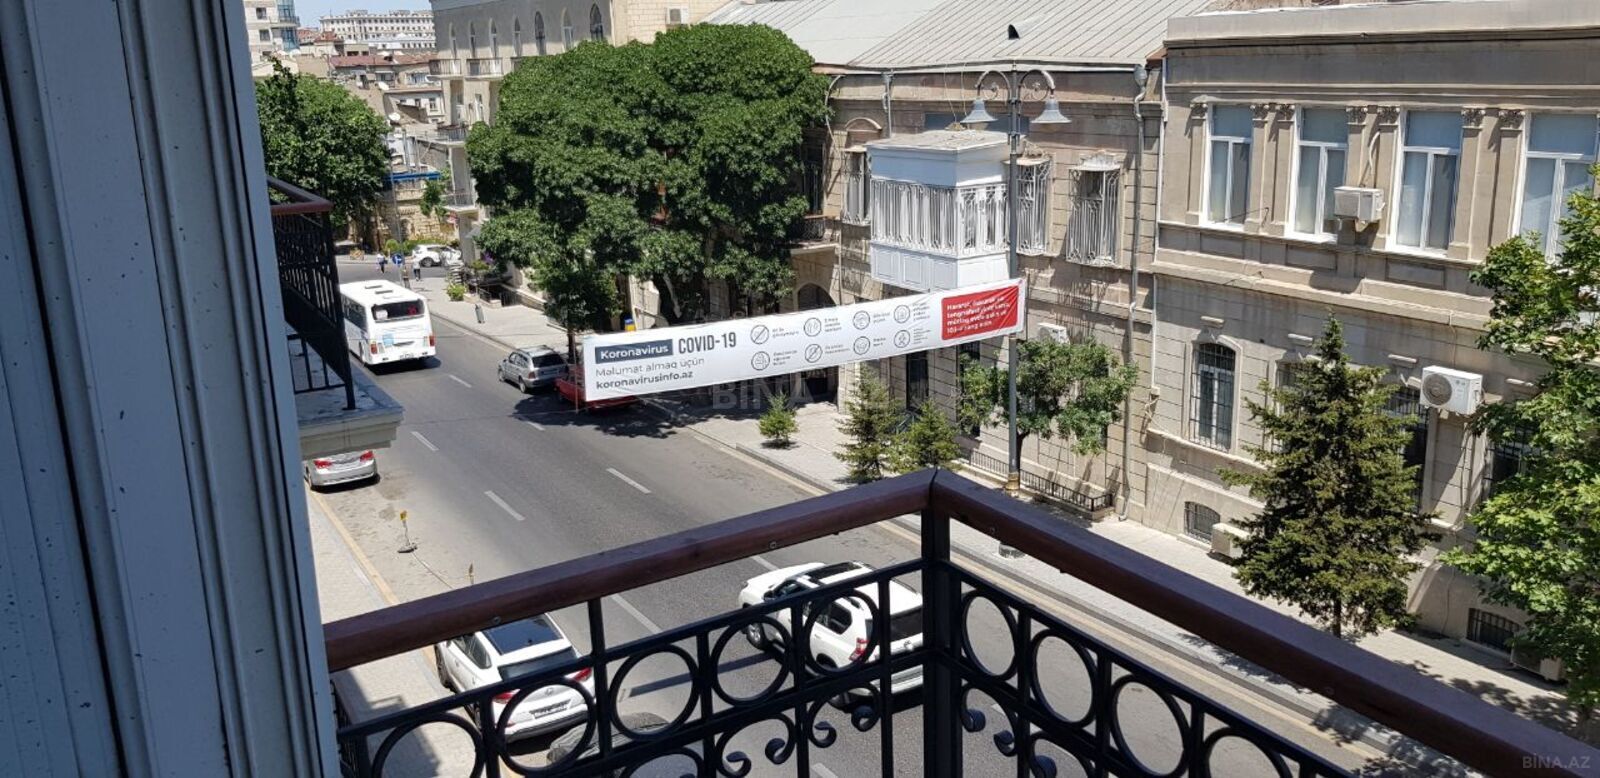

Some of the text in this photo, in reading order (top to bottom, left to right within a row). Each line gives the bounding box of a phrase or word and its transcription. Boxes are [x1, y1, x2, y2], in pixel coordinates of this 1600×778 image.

[600, 331, 737, 360] Koronavirus COVID-19
[596, 371, 694, 389] koronavirusinfo.az
